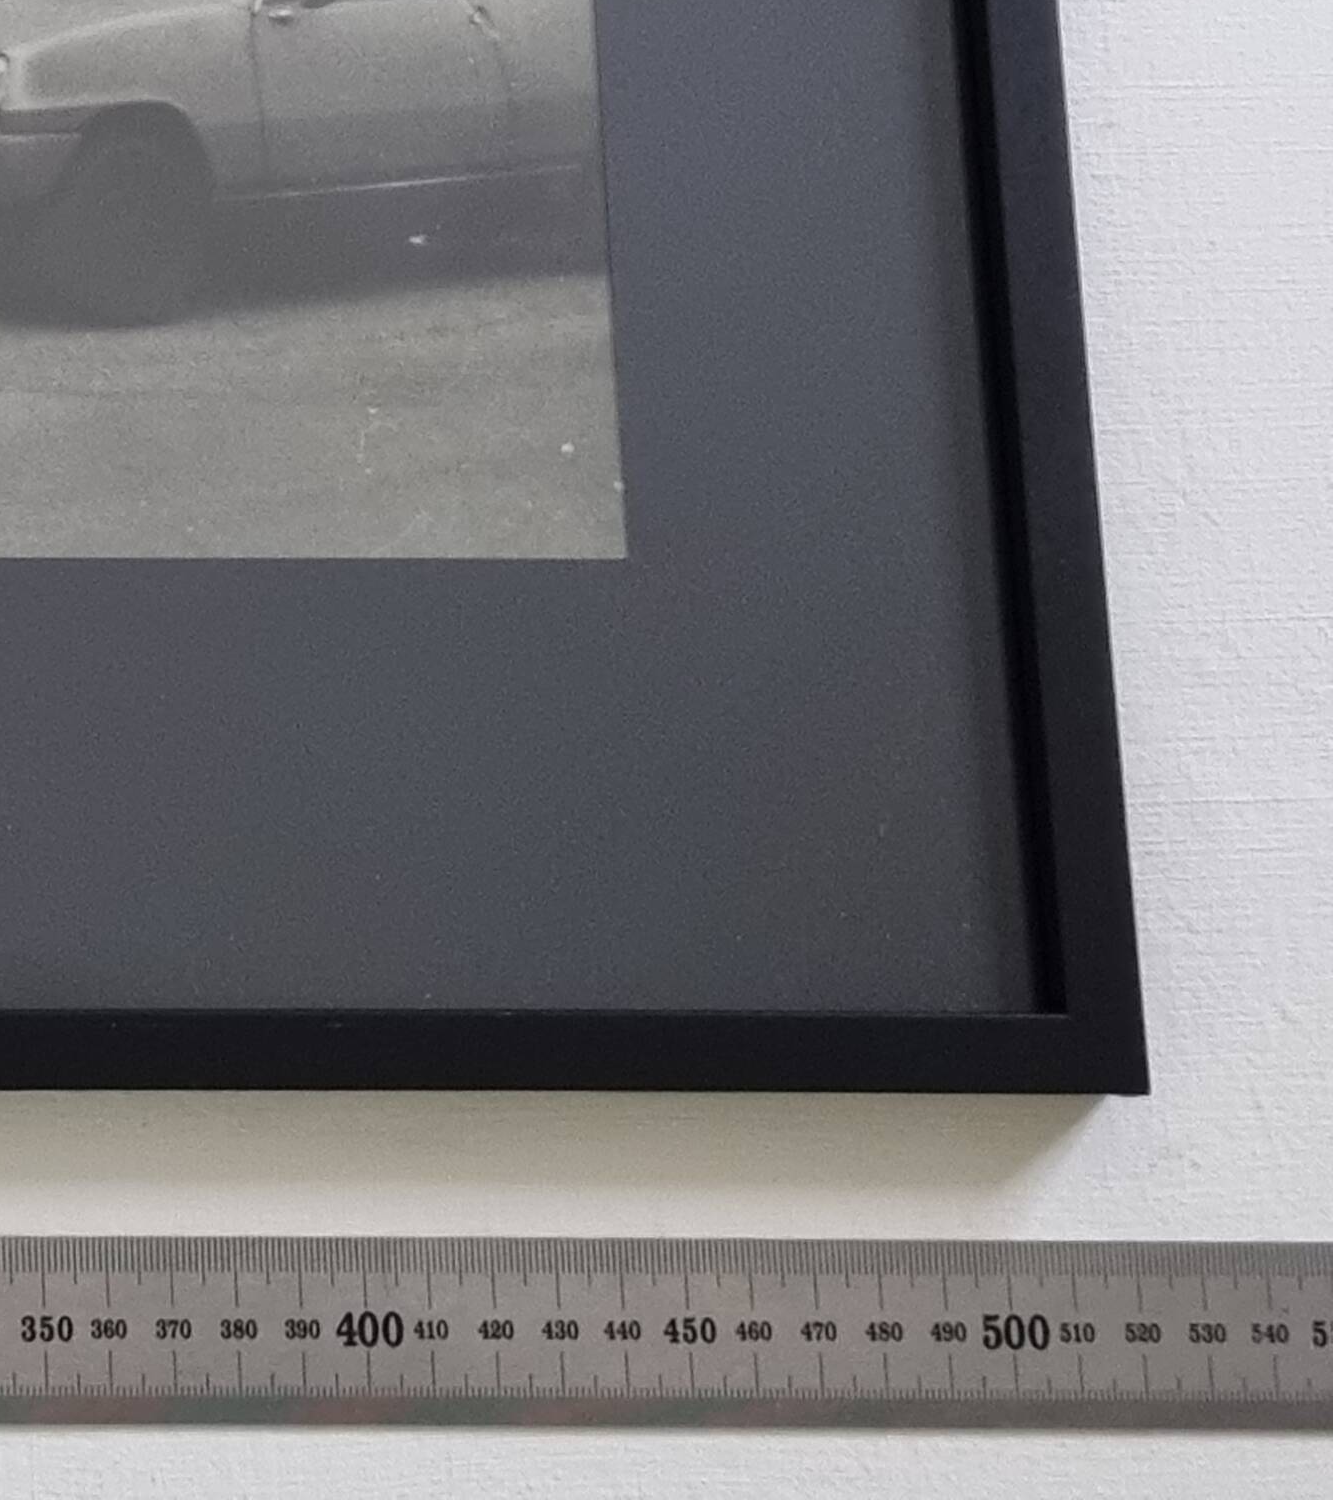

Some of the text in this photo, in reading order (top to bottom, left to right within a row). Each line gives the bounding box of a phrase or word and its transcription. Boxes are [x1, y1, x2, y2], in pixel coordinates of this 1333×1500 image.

[20, 1315, 74, 1343] 350
[90, 1318, 128, 1340] 360
[155, 1318, 192, 1340] 370
[220, 1318, 258, 1341] 380
[284, 1318, 321, 1340] 390
[335, 1313, 405, 1349] 400
[413, 1319, 449, 1341] 410
[477, 1319, 515, 1341] 420
[541, 1319, 580, 1341] 430
[603, 1319, 642, 1342] 440
[663, 1316, 717, 1345] 450
[735, 1320, 773, 1342] 460
[800, 1320, 837, 1342] 470
[865, 1321, 904, 1343] 480
[930, 1321, 967, 1343] 490
[982, 1313, 1051, 1351] 500
[1059, 1322, 1096, 1344] 510
[1125, 1322, 1162, 1344] 520
[1188, 1323, 1227, 1344] 530
[1251, 1323, 1290, 1344] 540
